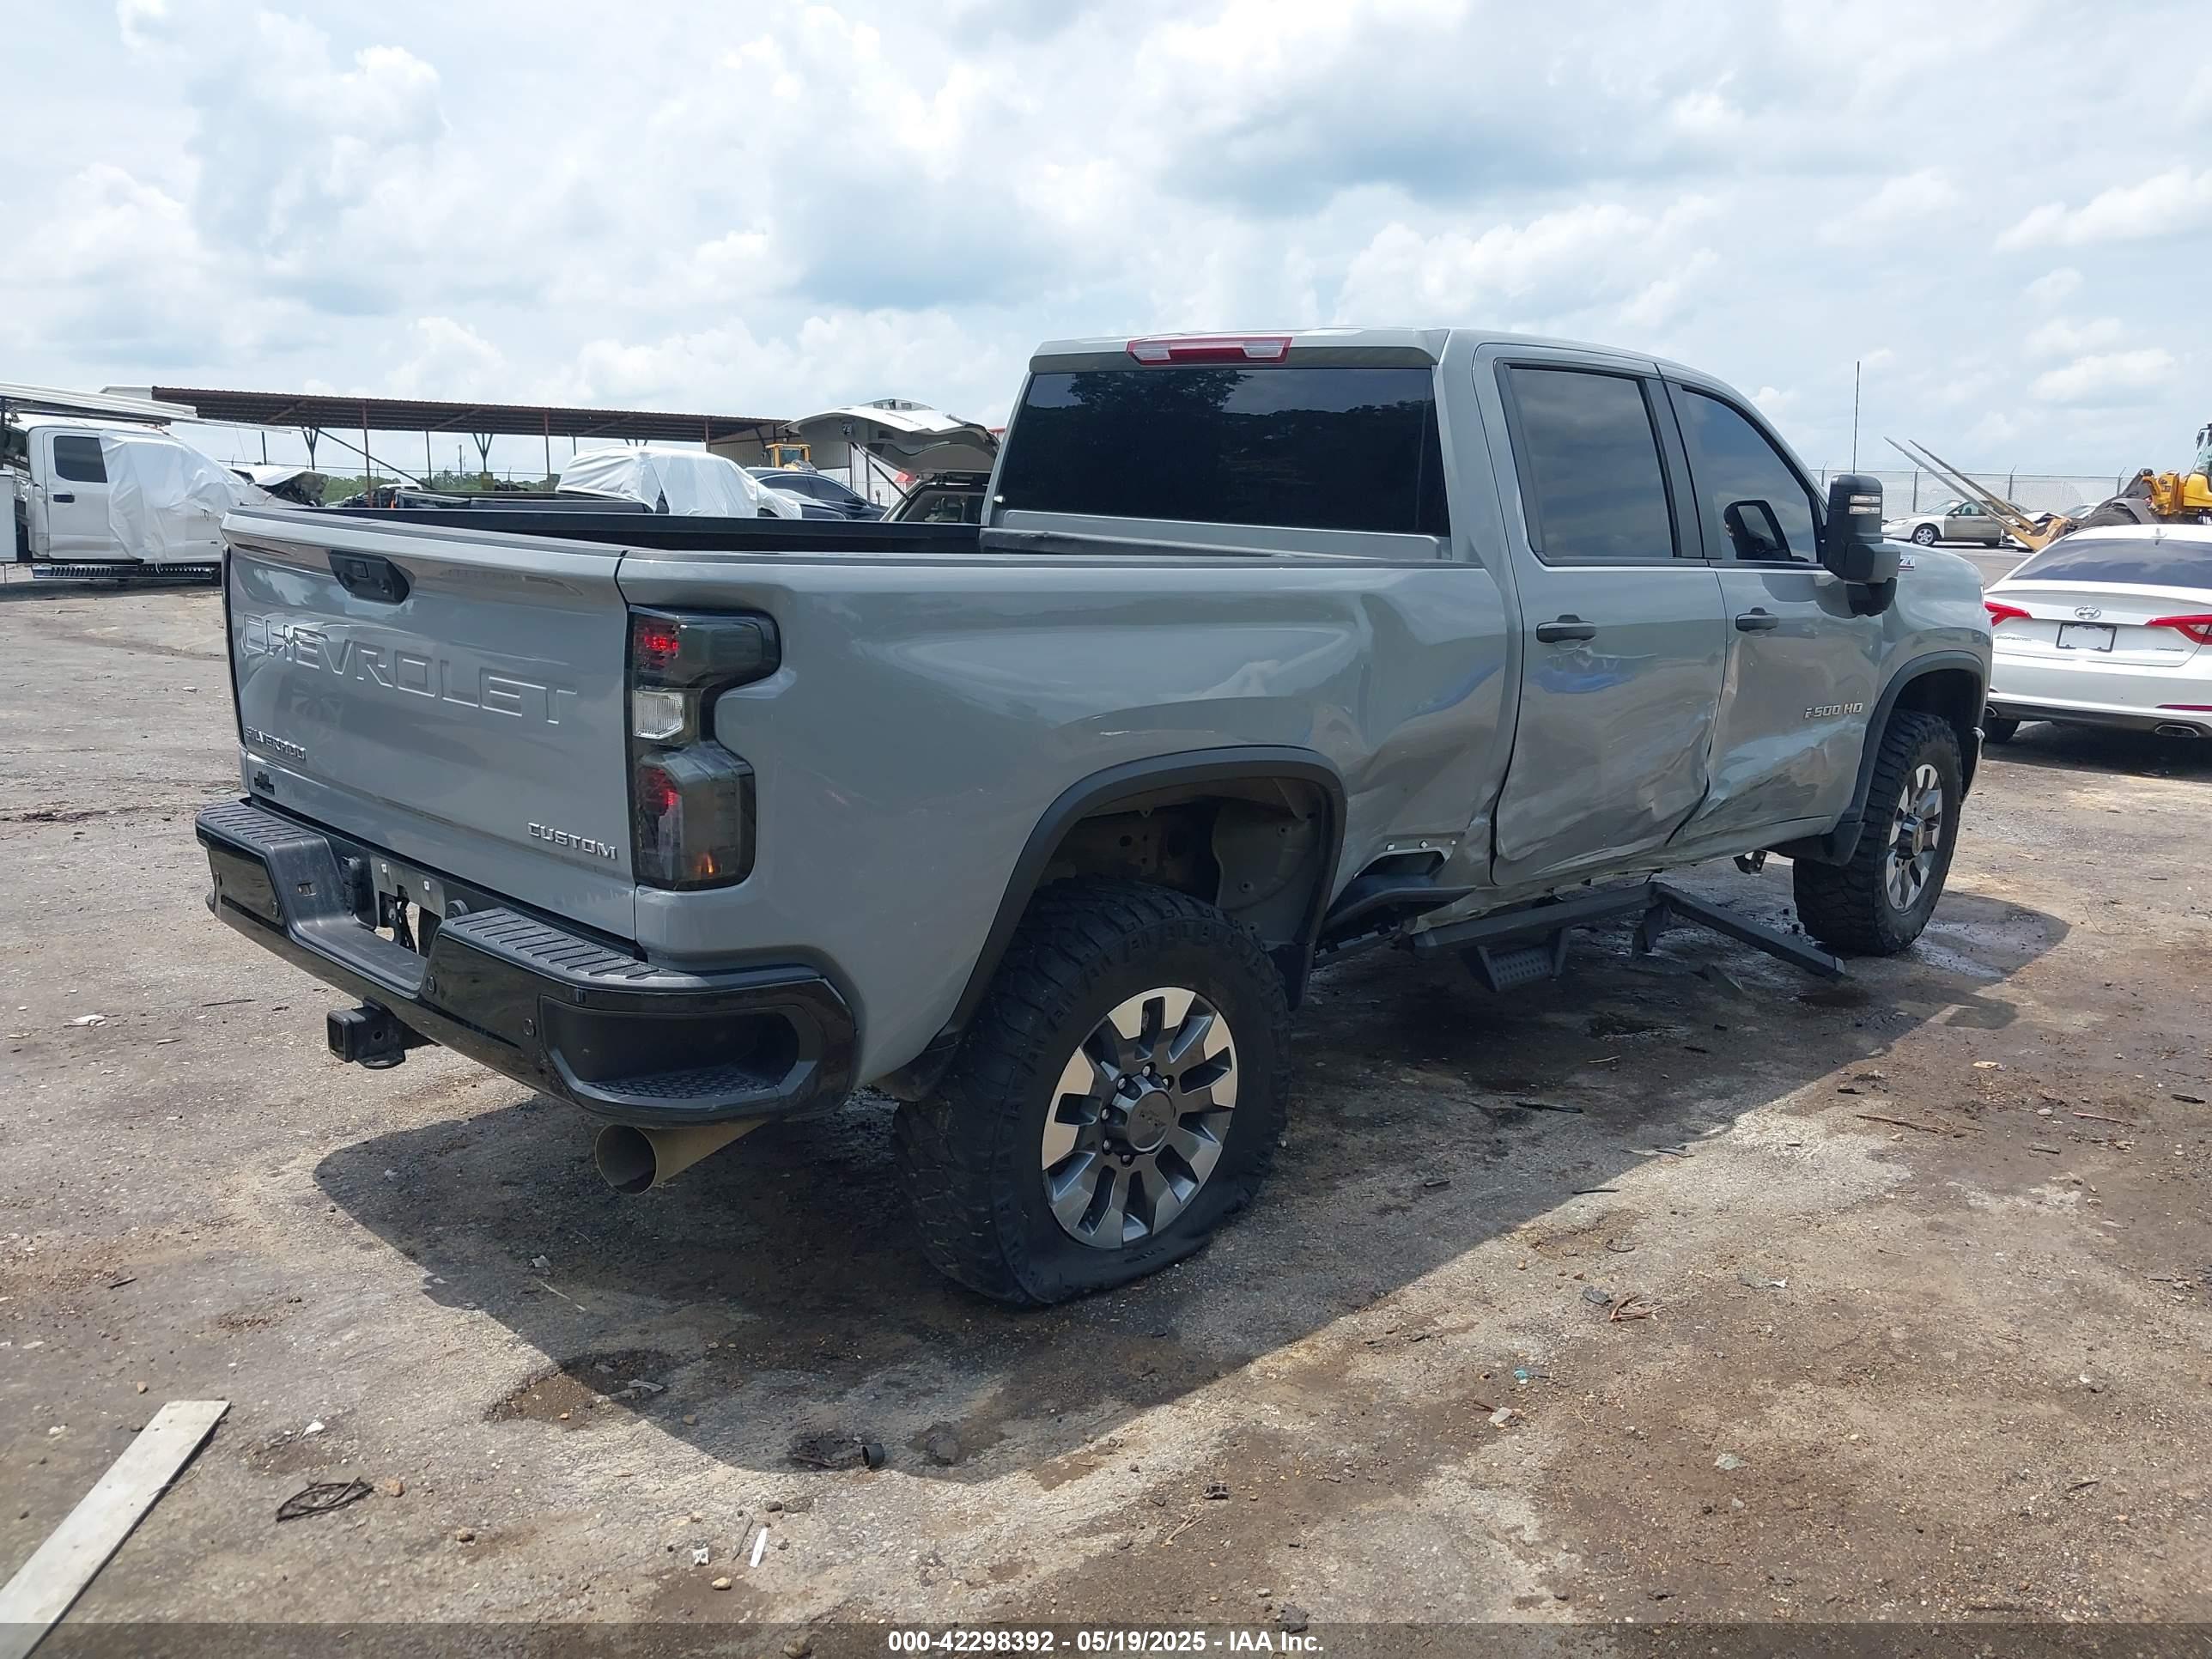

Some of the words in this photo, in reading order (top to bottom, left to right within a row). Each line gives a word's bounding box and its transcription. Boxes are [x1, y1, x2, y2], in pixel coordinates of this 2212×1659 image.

[244, 613, 578, 725] CHEVROLET
[1843, 702, 1863, 714] HD
[527, 822, 617, 860] CUSTOM
